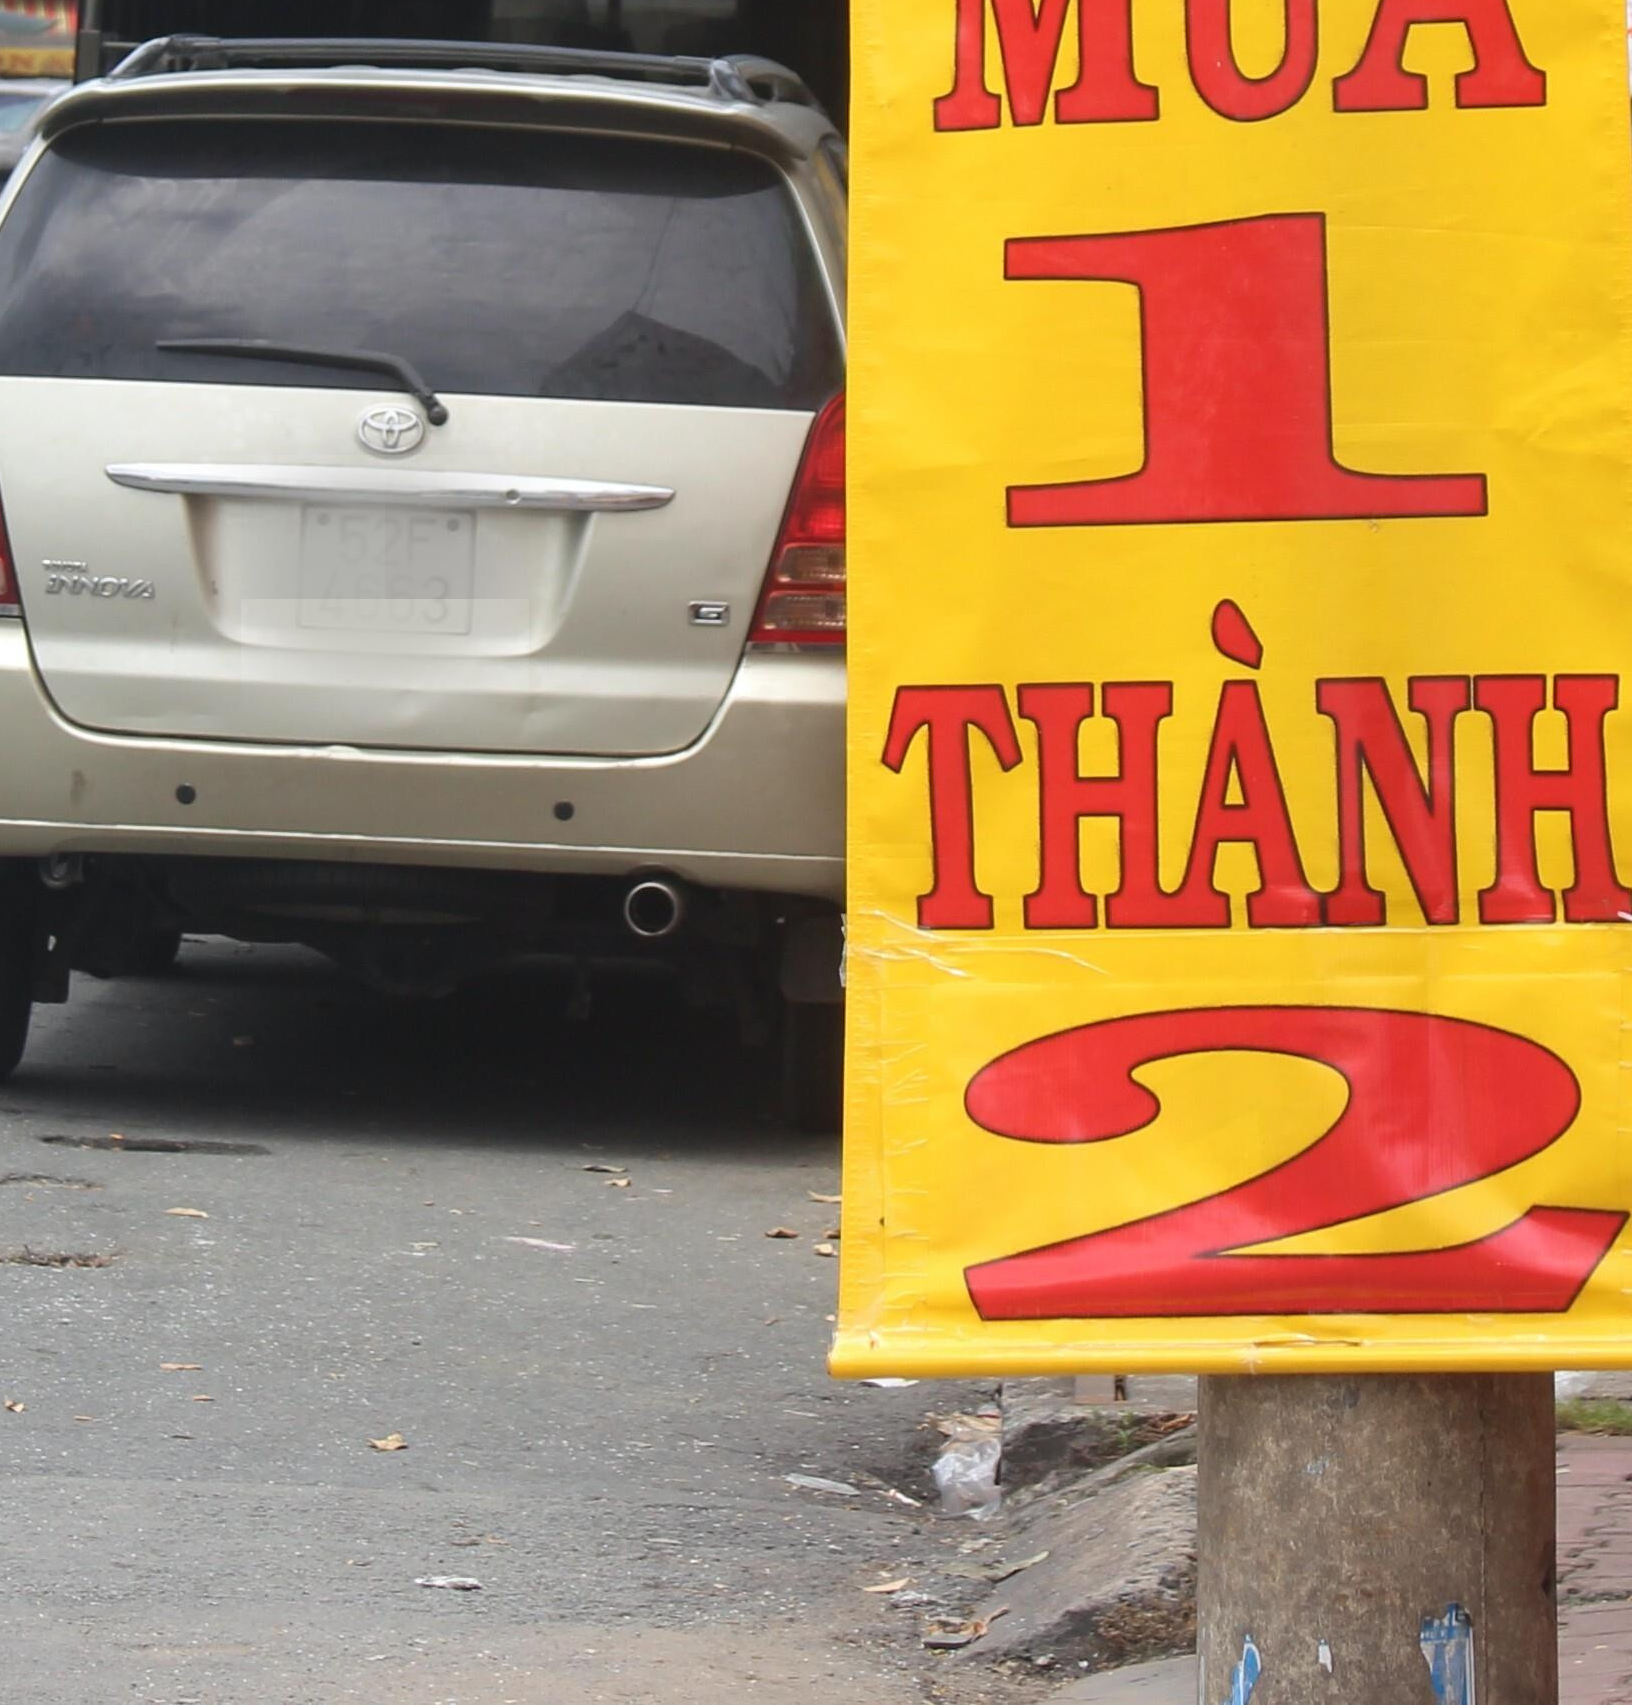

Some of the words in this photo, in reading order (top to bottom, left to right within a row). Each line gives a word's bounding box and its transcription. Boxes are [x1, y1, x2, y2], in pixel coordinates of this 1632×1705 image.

[1003, 212, 1489, 529] 1
[45, 574, 155, 599] INNOVA
[964, 1004, 1632, 1322] 2
